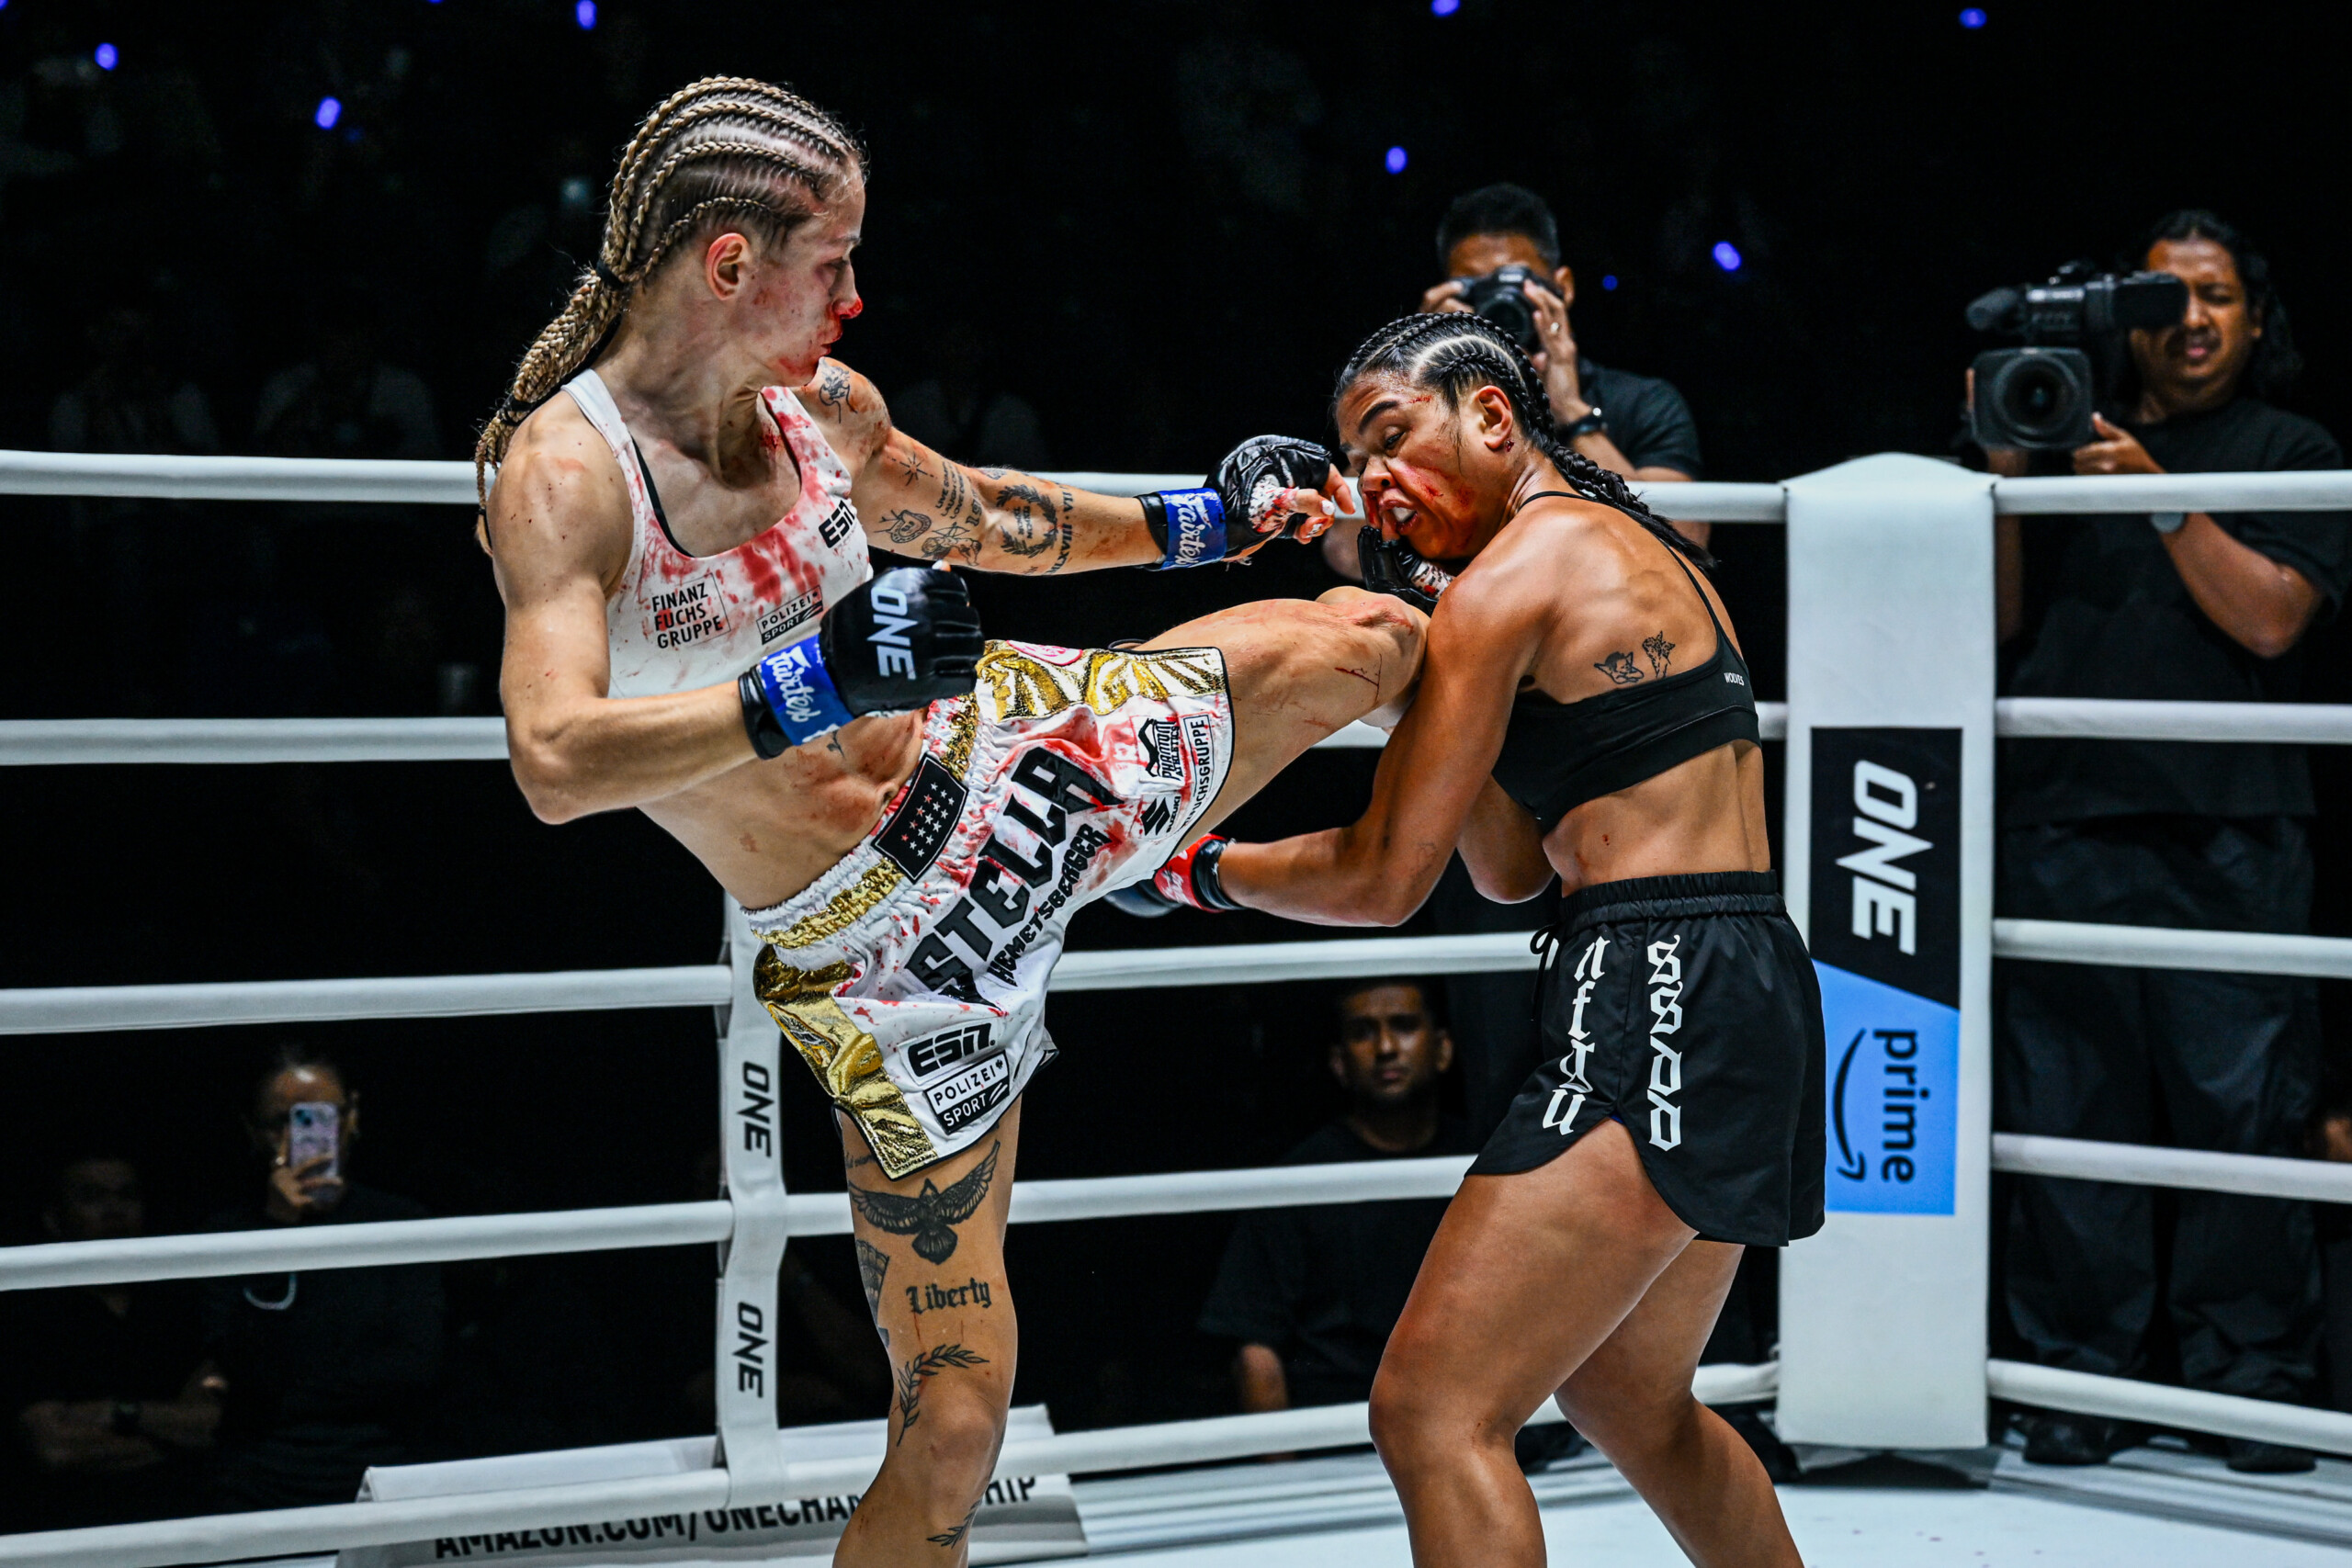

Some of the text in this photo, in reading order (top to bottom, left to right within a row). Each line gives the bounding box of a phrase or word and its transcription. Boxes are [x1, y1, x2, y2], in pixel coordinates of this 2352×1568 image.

[1170, 493, 1213, 565] Fairtex
[651, 582, 708, 613] FINANZ
[654, 603, 707, 632] FUCHS
[762, 595, 810, 629] POLIZEI
[657, 615, 723, 649] GRUPPE
[763, 615, 801, 642] SPORT
[866, 586, 919, 680] ONE
[765, 646, 821, 723] Fairtex
[1724, 672, 1745, 686] WOLVES
[1154, 720, 1182, 781] PHANTOM
[1170, 725, 1184, 778] ATHLETICS
[1166, 795, 1182, 833] SUZUKI
[904, 746, 1125, 1010] STELLA
[1835, 760, 1934, 956] ONE
[986, 823, 1113, 987] HEMETSBERGER
[908, 1022, 992, 1077] ESN
[737, 1061, 775, 1157] ONE
[933, 1065, 997, 1106] POLIZEI
[943, 1093, 988, 1127] SPORT
[1873, 1029, 1930, 1183] prime
[906, 1277, 991, 1314] Liberty
[732, 1302, 769, 1398] ONE
